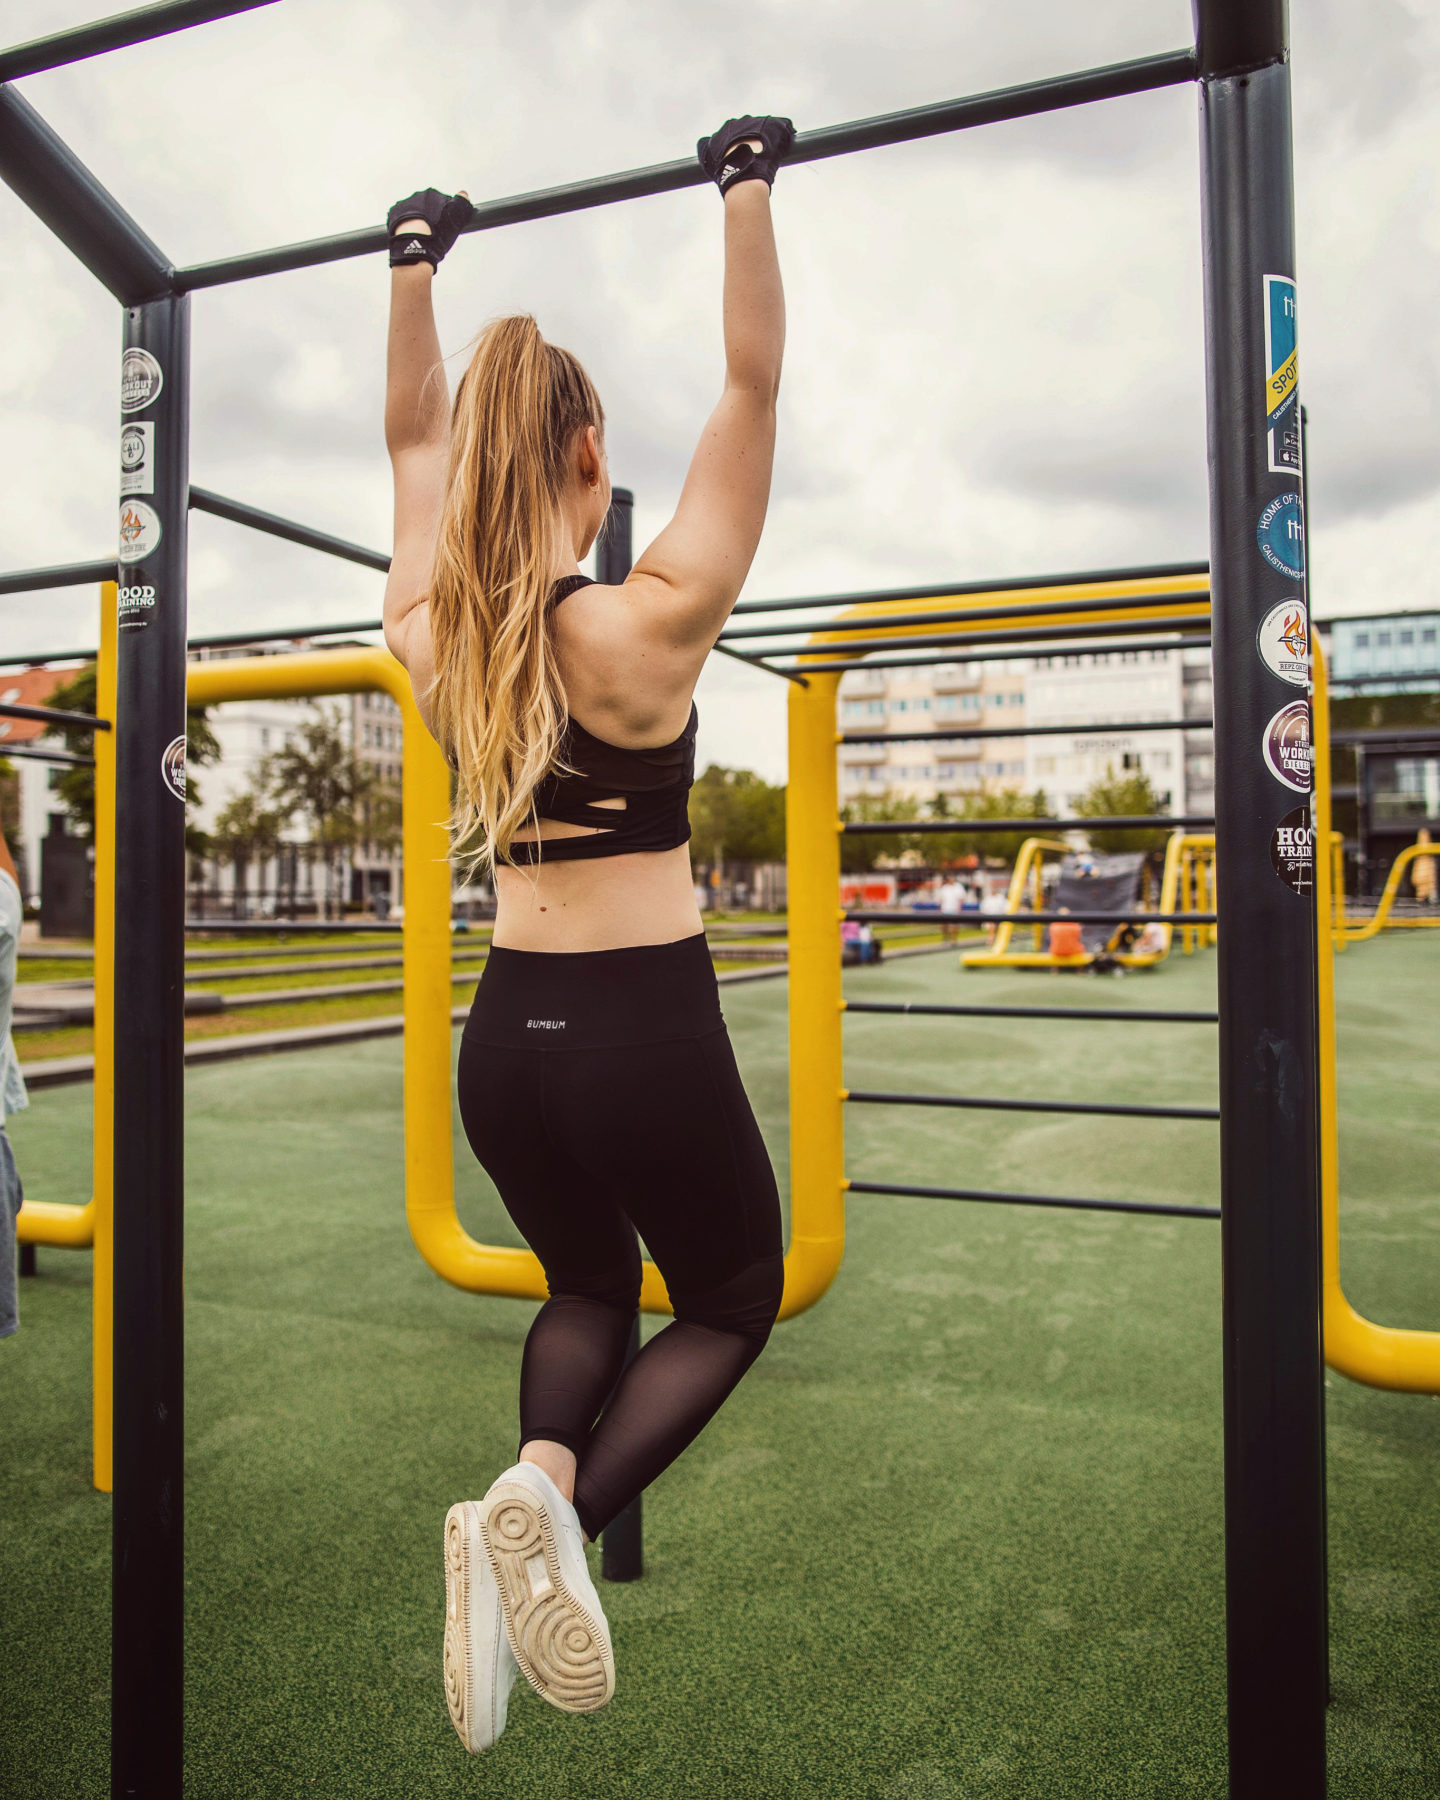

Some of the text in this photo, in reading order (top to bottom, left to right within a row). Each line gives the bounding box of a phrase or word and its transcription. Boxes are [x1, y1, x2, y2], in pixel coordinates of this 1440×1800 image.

[1260, 499, 1283, 529] HOME
[1282, 494, 1293, 505] OF
[119, 585, 155, 600] OOD
[527, 1020, 566, 1029] BUMBUM
